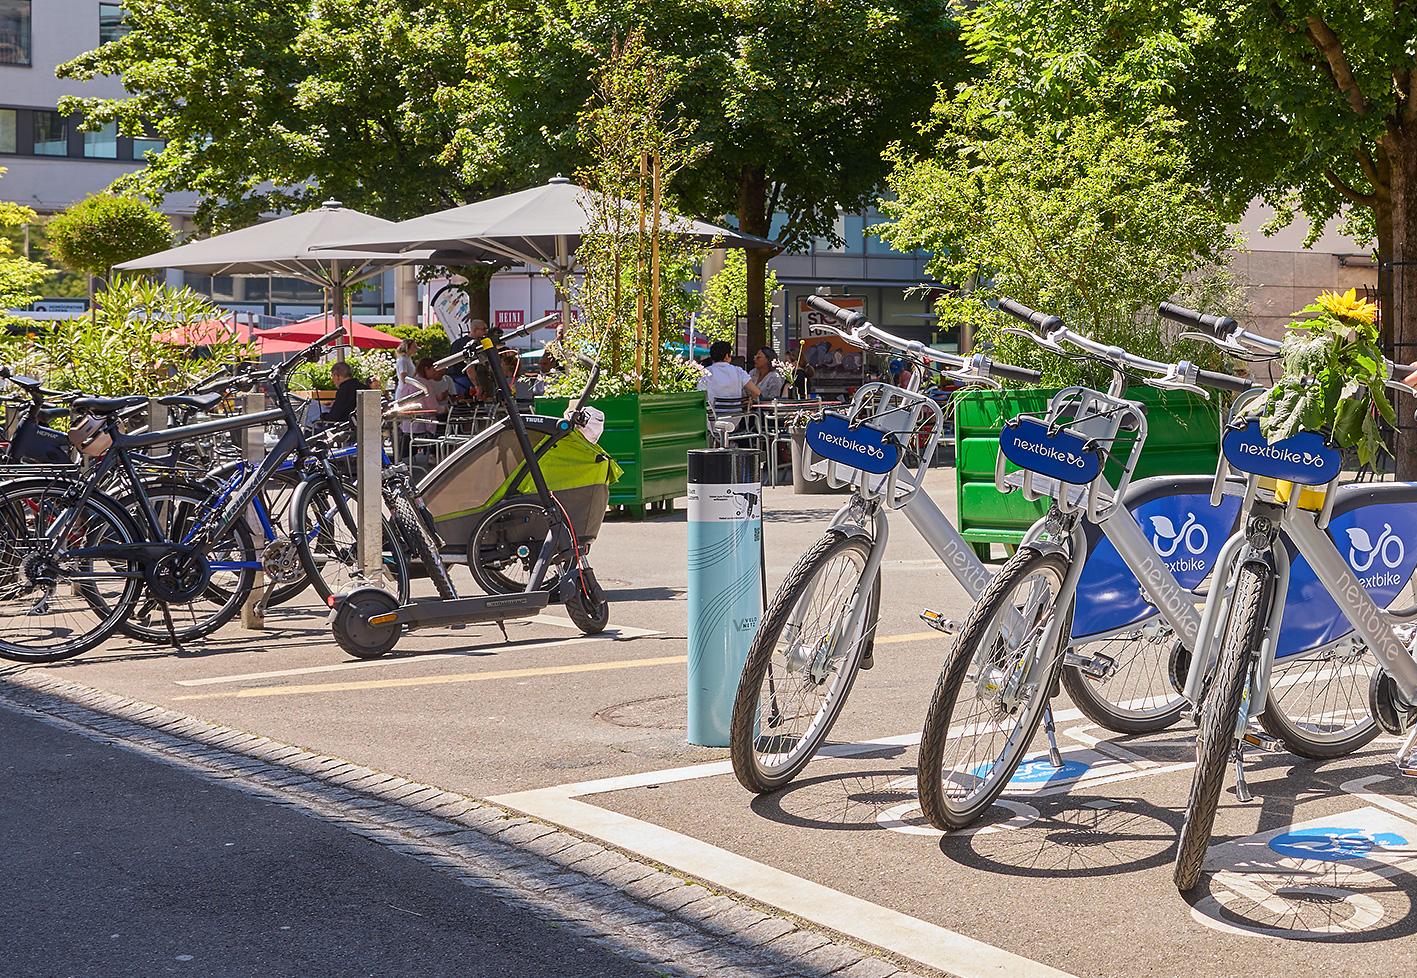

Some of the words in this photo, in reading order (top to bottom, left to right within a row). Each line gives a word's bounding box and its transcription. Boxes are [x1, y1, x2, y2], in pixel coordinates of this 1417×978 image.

[499, 312, 521, 323] HEINI
[818, 431, 867, 454] nextbike
[1013, 437, 1066, 462] nextbike
[1239, 443, 1301, 463] nextbike
[943, 539, 987, 592] nextb
[1164, 557, 1205, 572] extbike
[1358, 572, 1401, 588] extbike
[1139, 556, 1198, 637] nextbike
[1336, 571, 1399, 661] nextbike
